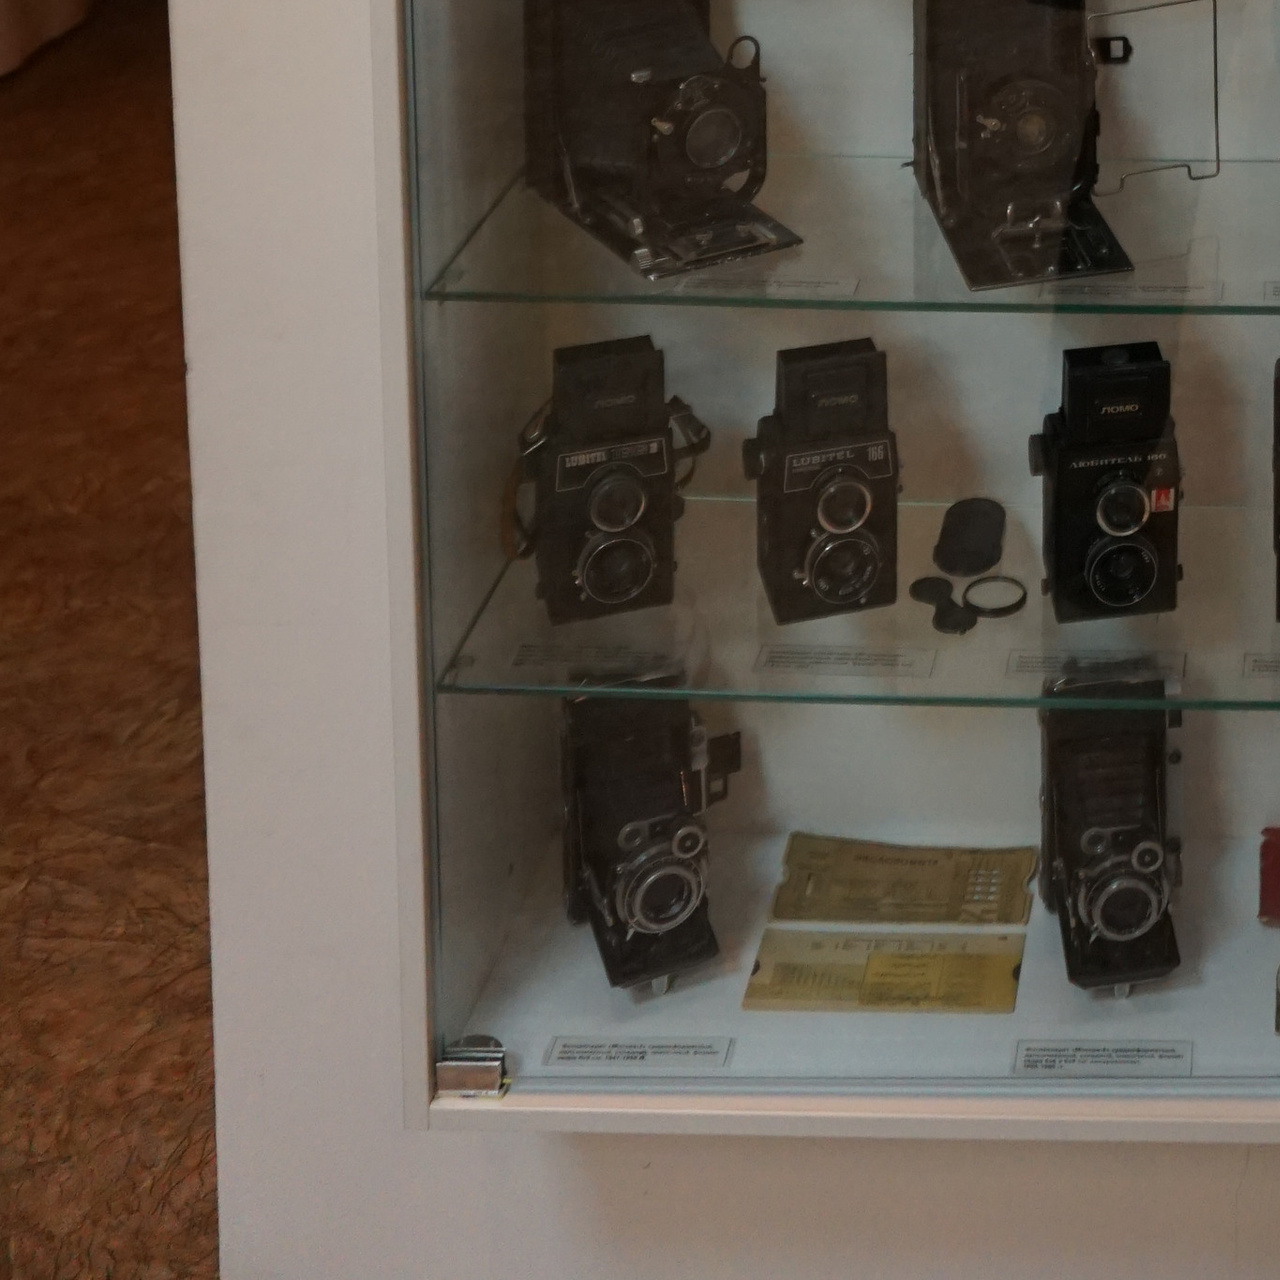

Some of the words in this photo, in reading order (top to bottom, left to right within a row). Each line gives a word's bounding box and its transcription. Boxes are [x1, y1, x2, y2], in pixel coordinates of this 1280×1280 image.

[1101, 404, 1139, 414] ЛОМО
[792, 450, 855, 467] LUBITEL
[867, 446, 884, 461] 166
[1070, 455, 1142, 468] ЛЮБИТЕЛЬ
